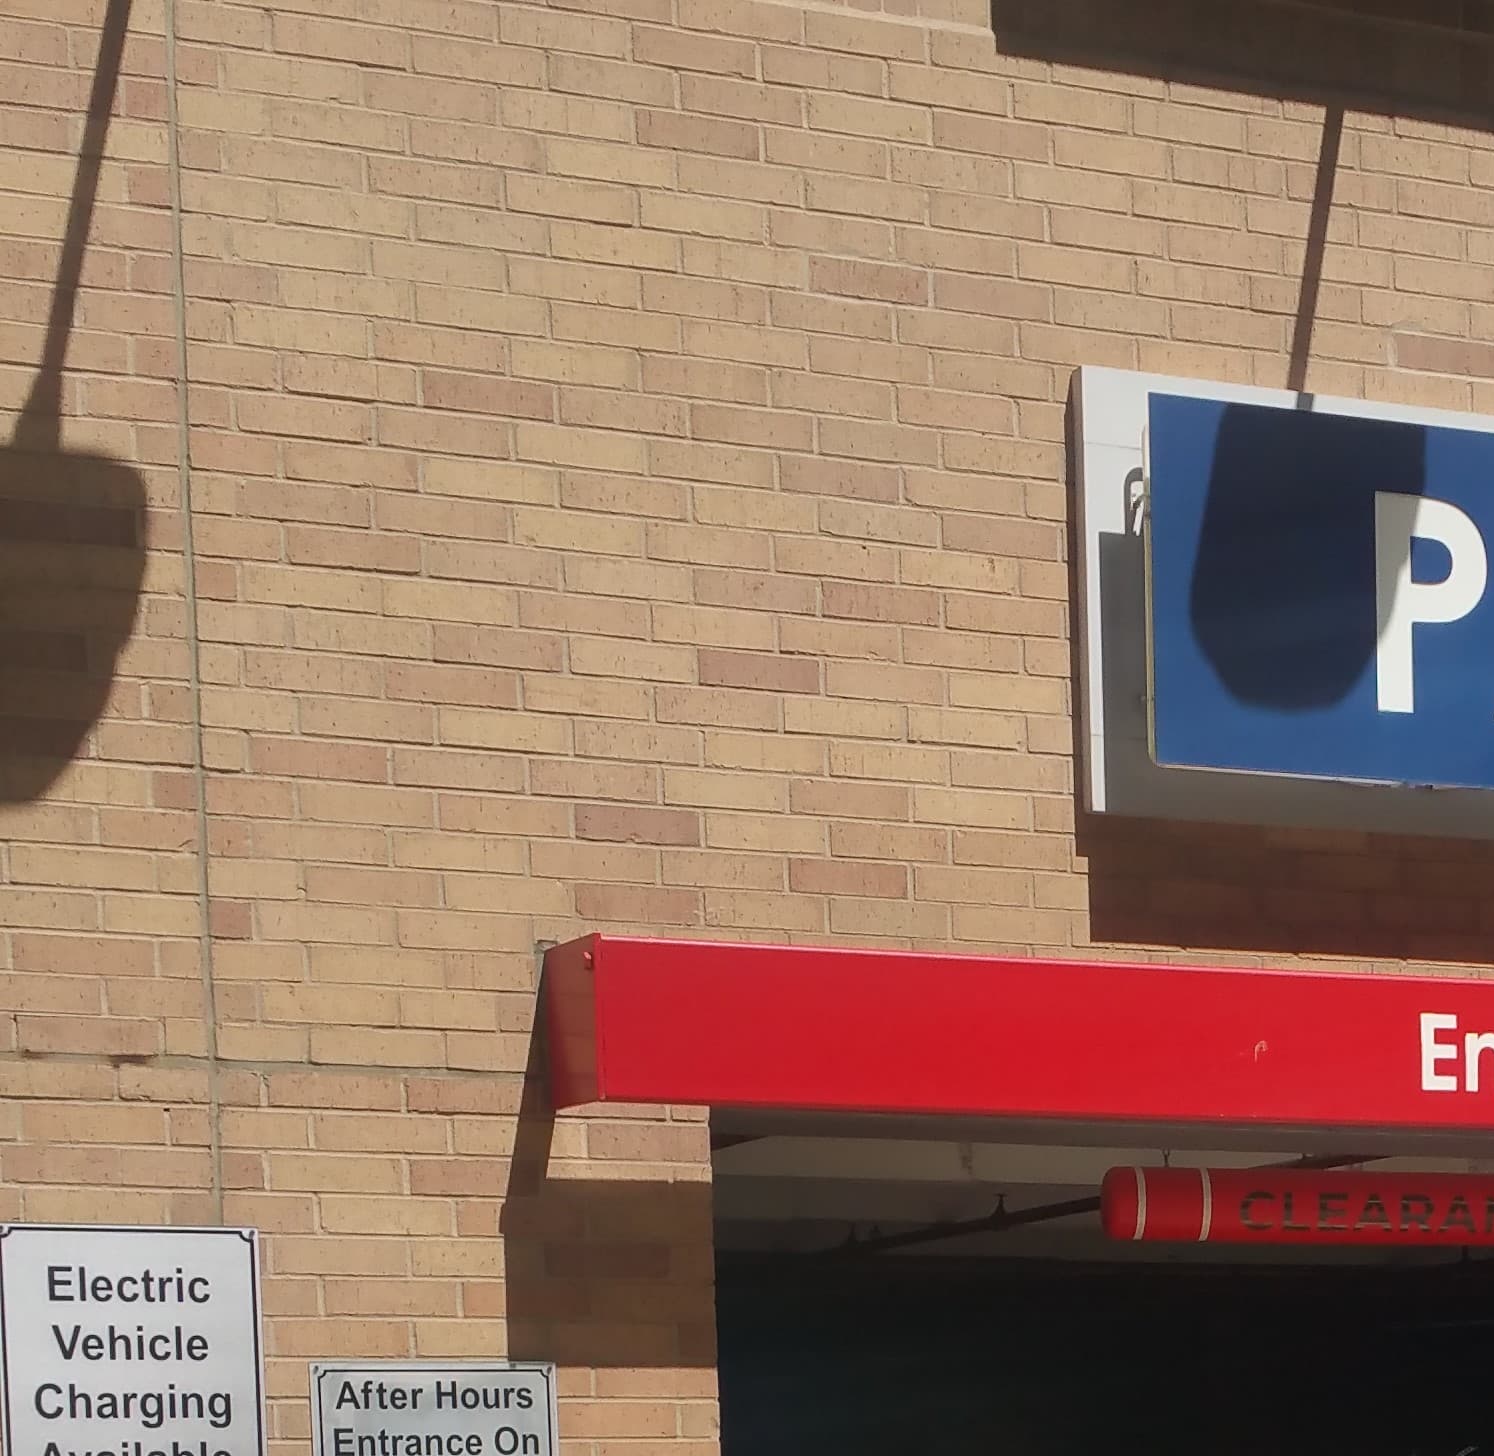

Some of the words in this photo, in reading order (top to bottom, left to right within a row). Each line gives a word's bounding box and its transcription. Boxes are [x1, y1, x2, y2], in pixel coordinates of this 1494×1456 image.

[47, 1265, 210, 1303] Electric
[52, 1324, 209, 1362] Vehicle
[34, 1383, 233, 1429] Charging
[335, 1380, 423, 1410] After
[435, 1380, 534, 1410] Hours
[333, 1426, 483, 1456] Entrance
[494, 1426, 541, 1456] On
